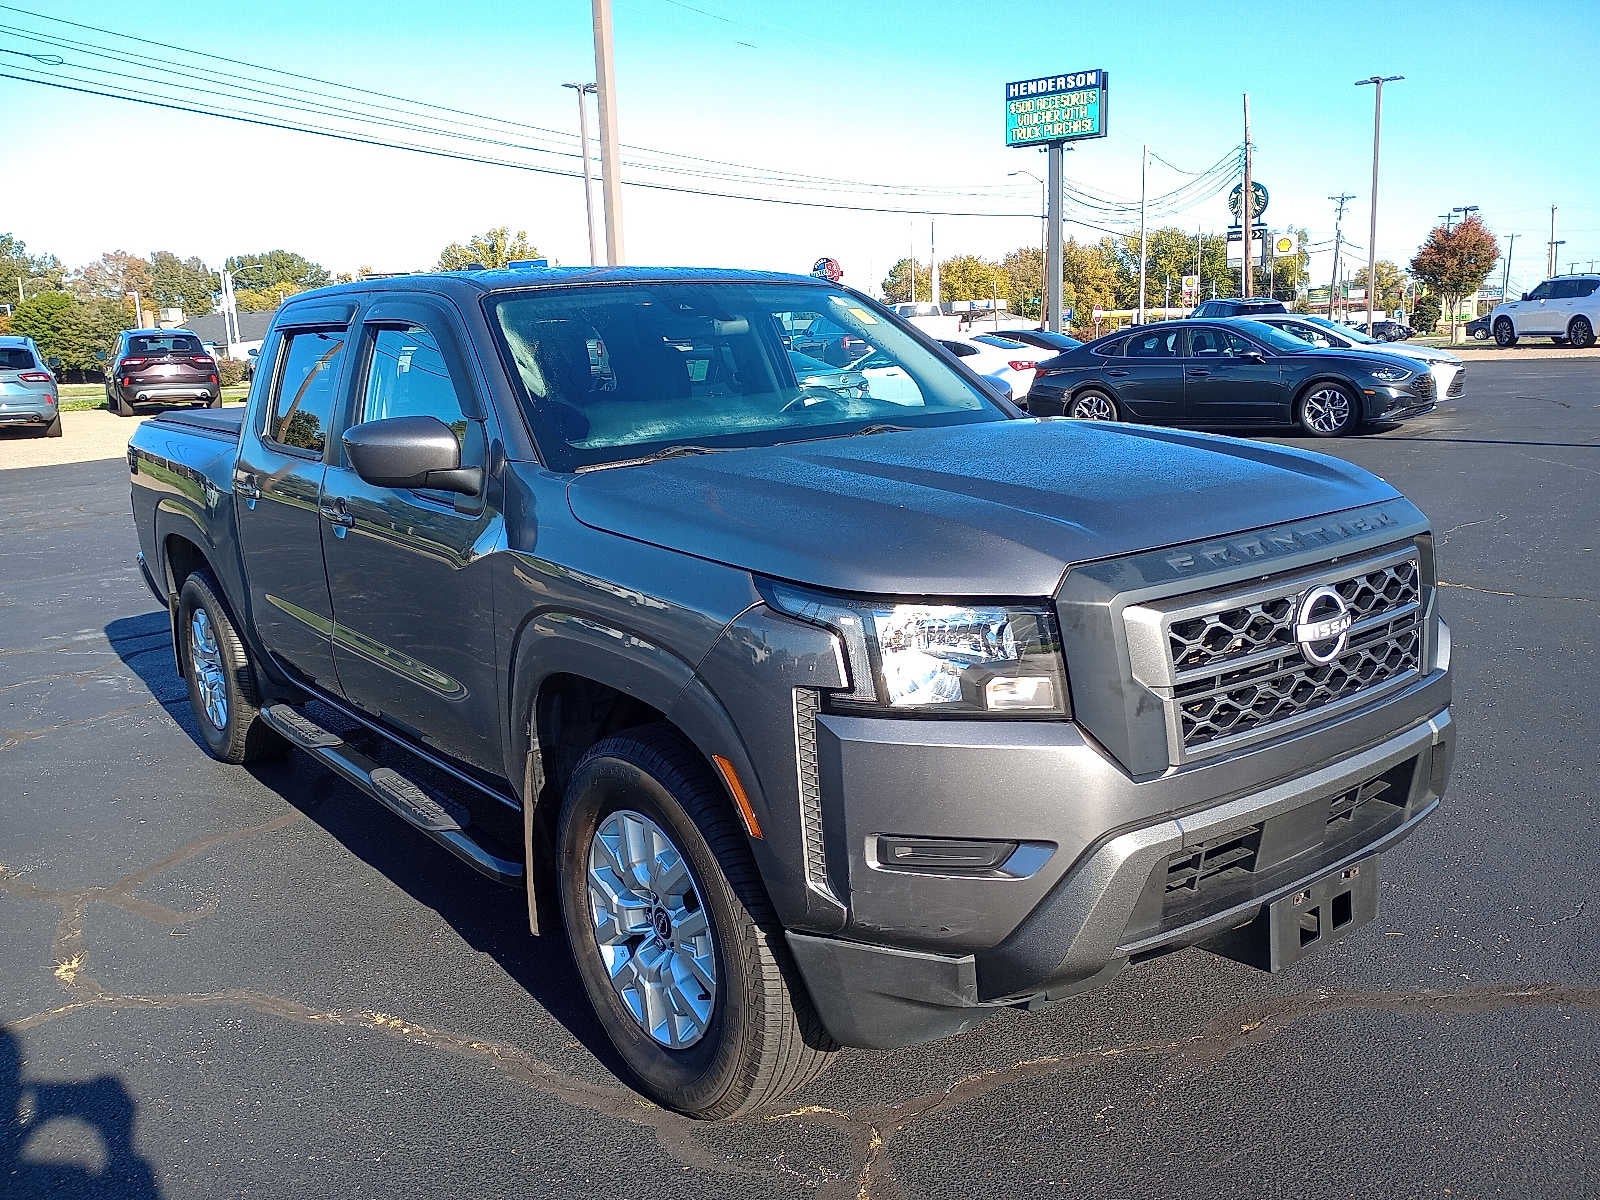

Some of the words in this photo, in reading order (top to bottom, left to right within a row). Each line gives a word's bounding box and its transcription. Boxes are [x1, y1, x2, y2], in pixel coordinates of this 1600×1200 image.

[1009, 72, 1096, 97] HENDERSON
[1018, 109, 1060, 125] VOUCHER
[1062, 106, 1087, 120] WITH
[1012, 126, 1041, 140] TRUCK
[1043, 119, 1093, 136] PURCHASE
[1166, 512, 1399, 573] FRONTIER
[1299, 615, 1351, 642] ISSAN
